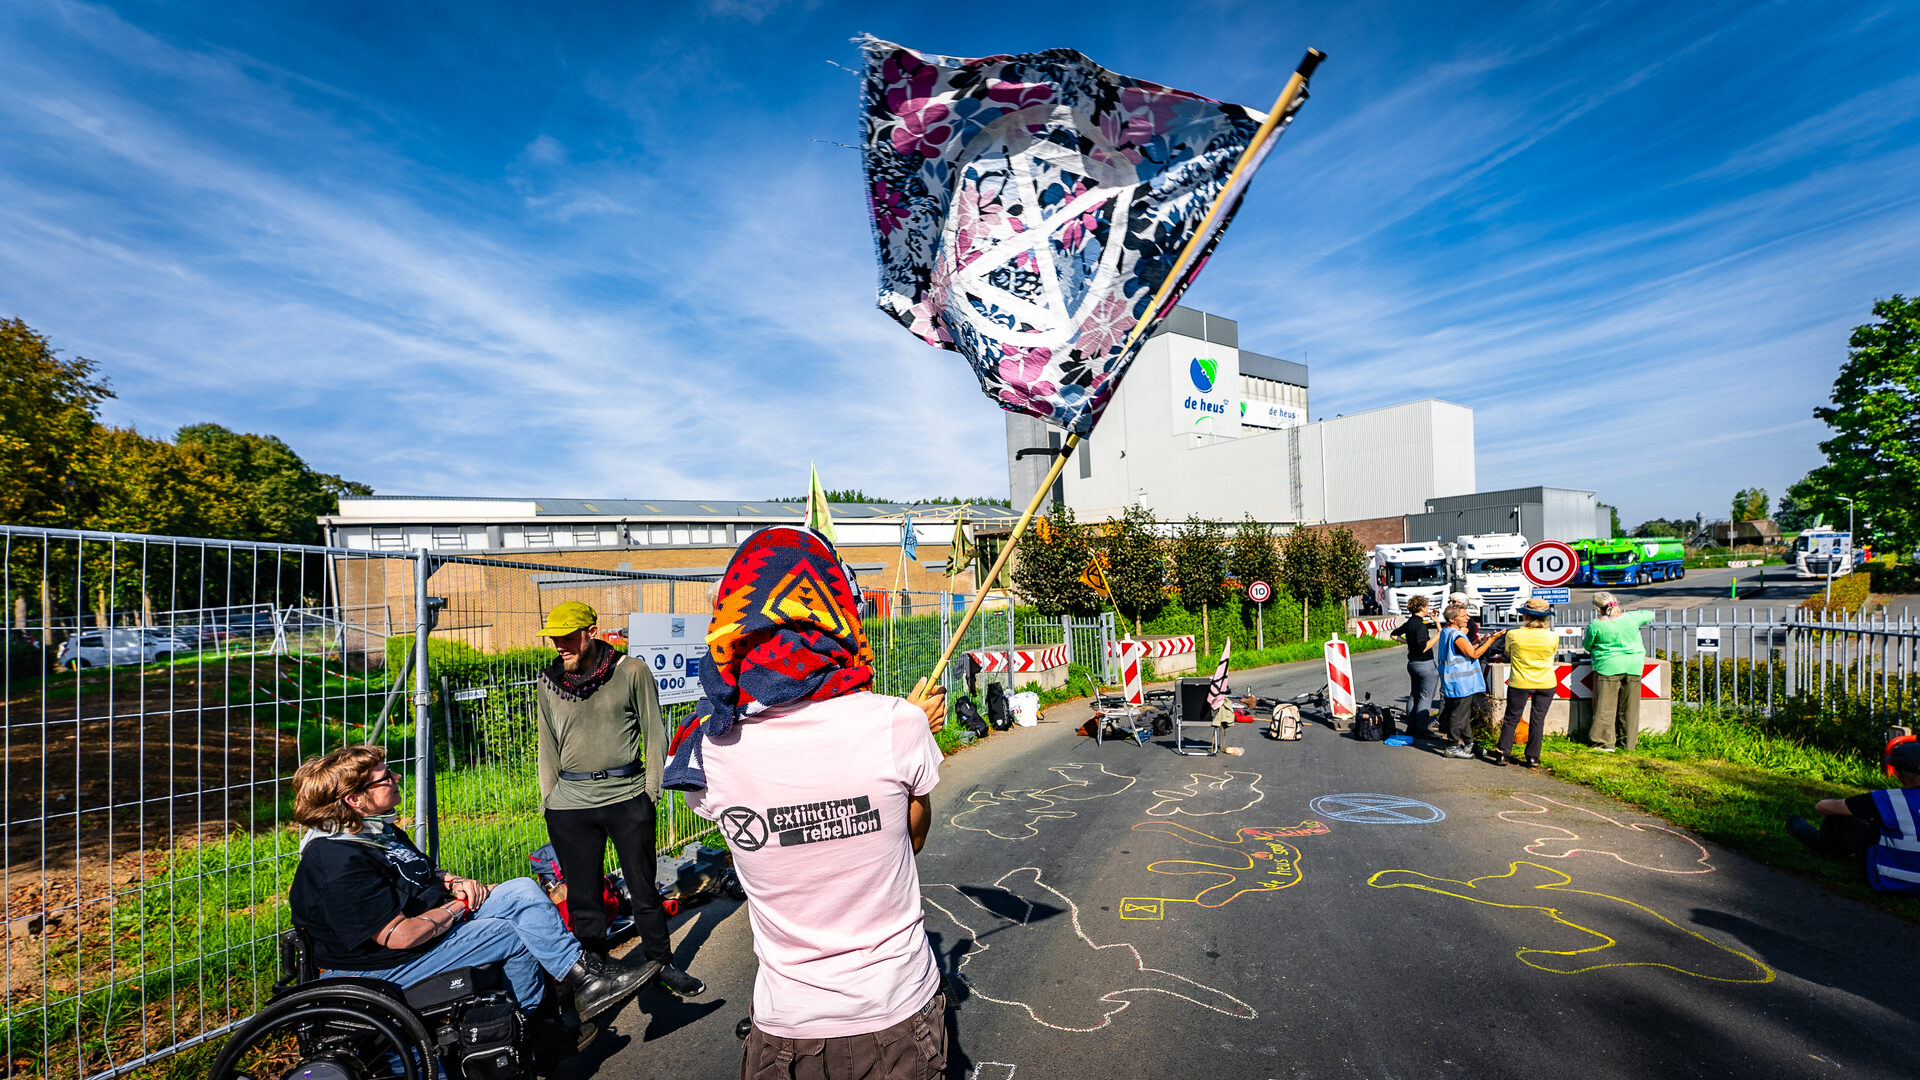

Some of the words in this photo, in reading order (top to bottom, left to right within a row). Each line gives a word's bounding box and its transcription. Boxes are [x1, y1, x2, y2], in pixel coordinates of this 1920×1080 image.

[1184, 396, 1197, 410] de
[1200, 398, 1225, 414] heus
[1268, 407, 1278, 416] de
[1279, 408, 1296, 419] heus
[1536, 556, 1563, 573] 10
[1254, 587, 1266, 596] 10
[773, 803, 857, 826] extinction
[803, 817, 879, 842] rebellion
